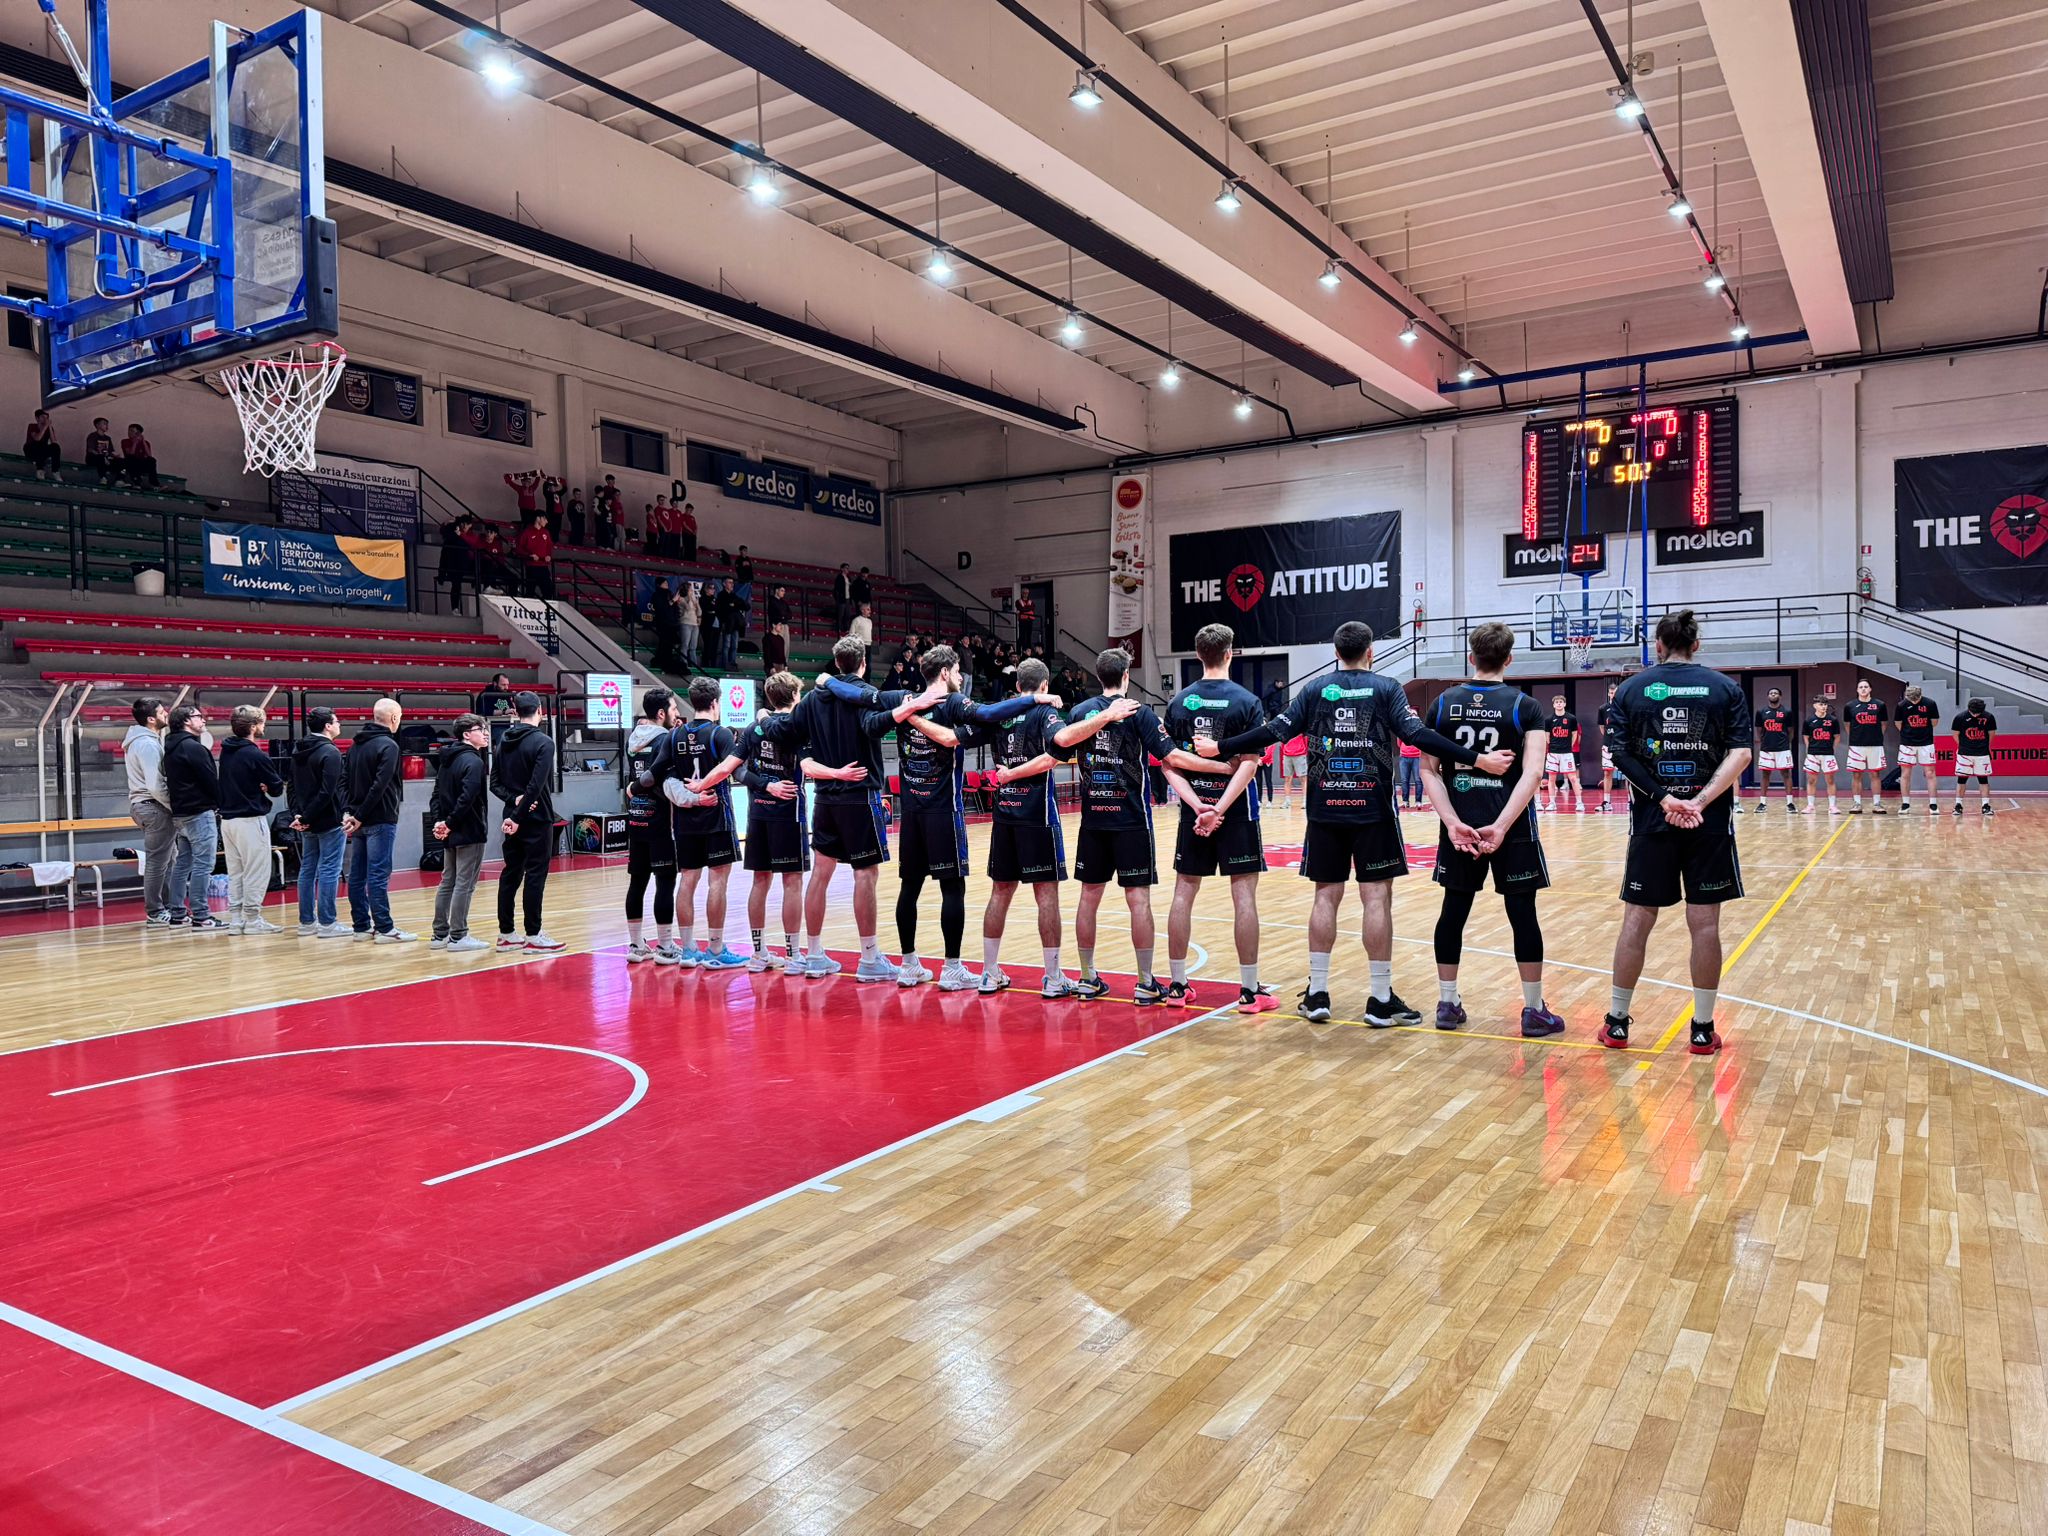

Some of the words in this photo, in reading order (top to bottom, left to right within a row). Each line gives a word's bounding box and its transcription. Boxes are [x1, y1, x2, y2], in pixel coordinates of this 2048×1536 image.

[1599, 425, 1611, 444] 0
[1665, 417, 1677, 435] 0
[1589, 451, 1599, 465] 0
[1655, 444, 1665, 457] 0
[343, 469, 411, 487] Assicurazioni
[747, 470, 796, 499] redeo
[671, 479, 687, 502] D
[832, 489, 875, 514] redeo
[1666, 528, 1753, 551] molten
[1913, 515, 1981, 548] THE
[280, 540, 313, 551] BANCA
[1515, 543, 1565, 565] molt
[1572, 543, 1599, 563] 24
[281, 550, 324, 561] TERRITORI
[281, 558, 296, 566] DEL
[298, 559, 342, 571] MONVISO
[958, 551, 972, 570] D
[299, 584, 317, 595] per
[324, 585, 344, 595] tuoi
[1181, 579, 1222, 604] THE
[1270, 561, 1389, 597] ATTITUDE
[1466, 708, 1502, 718] INFOCIA
[1335, 738, 1373, 748] Renexia
[1664, 740, 1709, 750] Renexia
[1991, 748, 2048, 760] TTITUDE
[1331, 761, 1360, 769] ISEF
[1662, 765, 1692, 773] ISEF
[608, 820, 626, 834] FIBA
